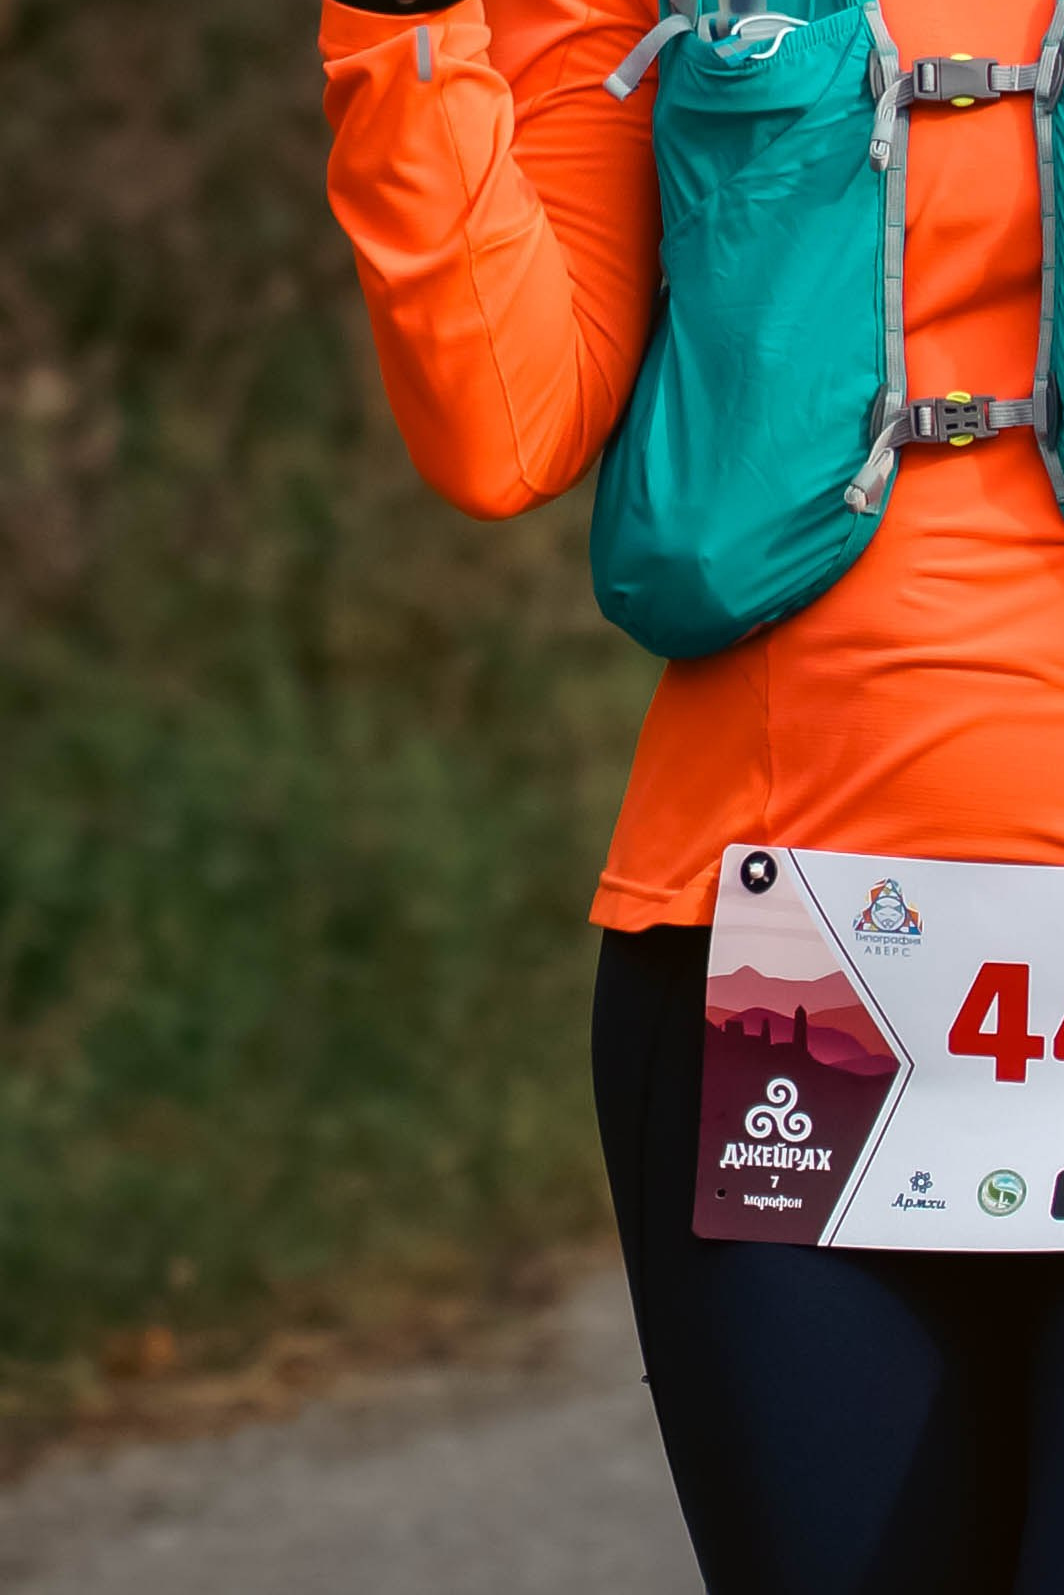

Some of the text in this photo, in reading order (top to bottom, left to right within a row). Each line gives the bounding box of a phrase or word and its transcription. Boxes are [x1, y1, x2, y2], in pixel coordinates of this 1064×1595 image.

[855, 932, 922, 946] Типография
[863, 945, 912, 958] АВЕРС
[719, 1142, 832, 1172] ДЖЕЙРАХ
[770, 1175, 780, 1189] 7
[743, 1194, 802, 1212] марафон
[891, 1192, 947, 1212] Армхи
